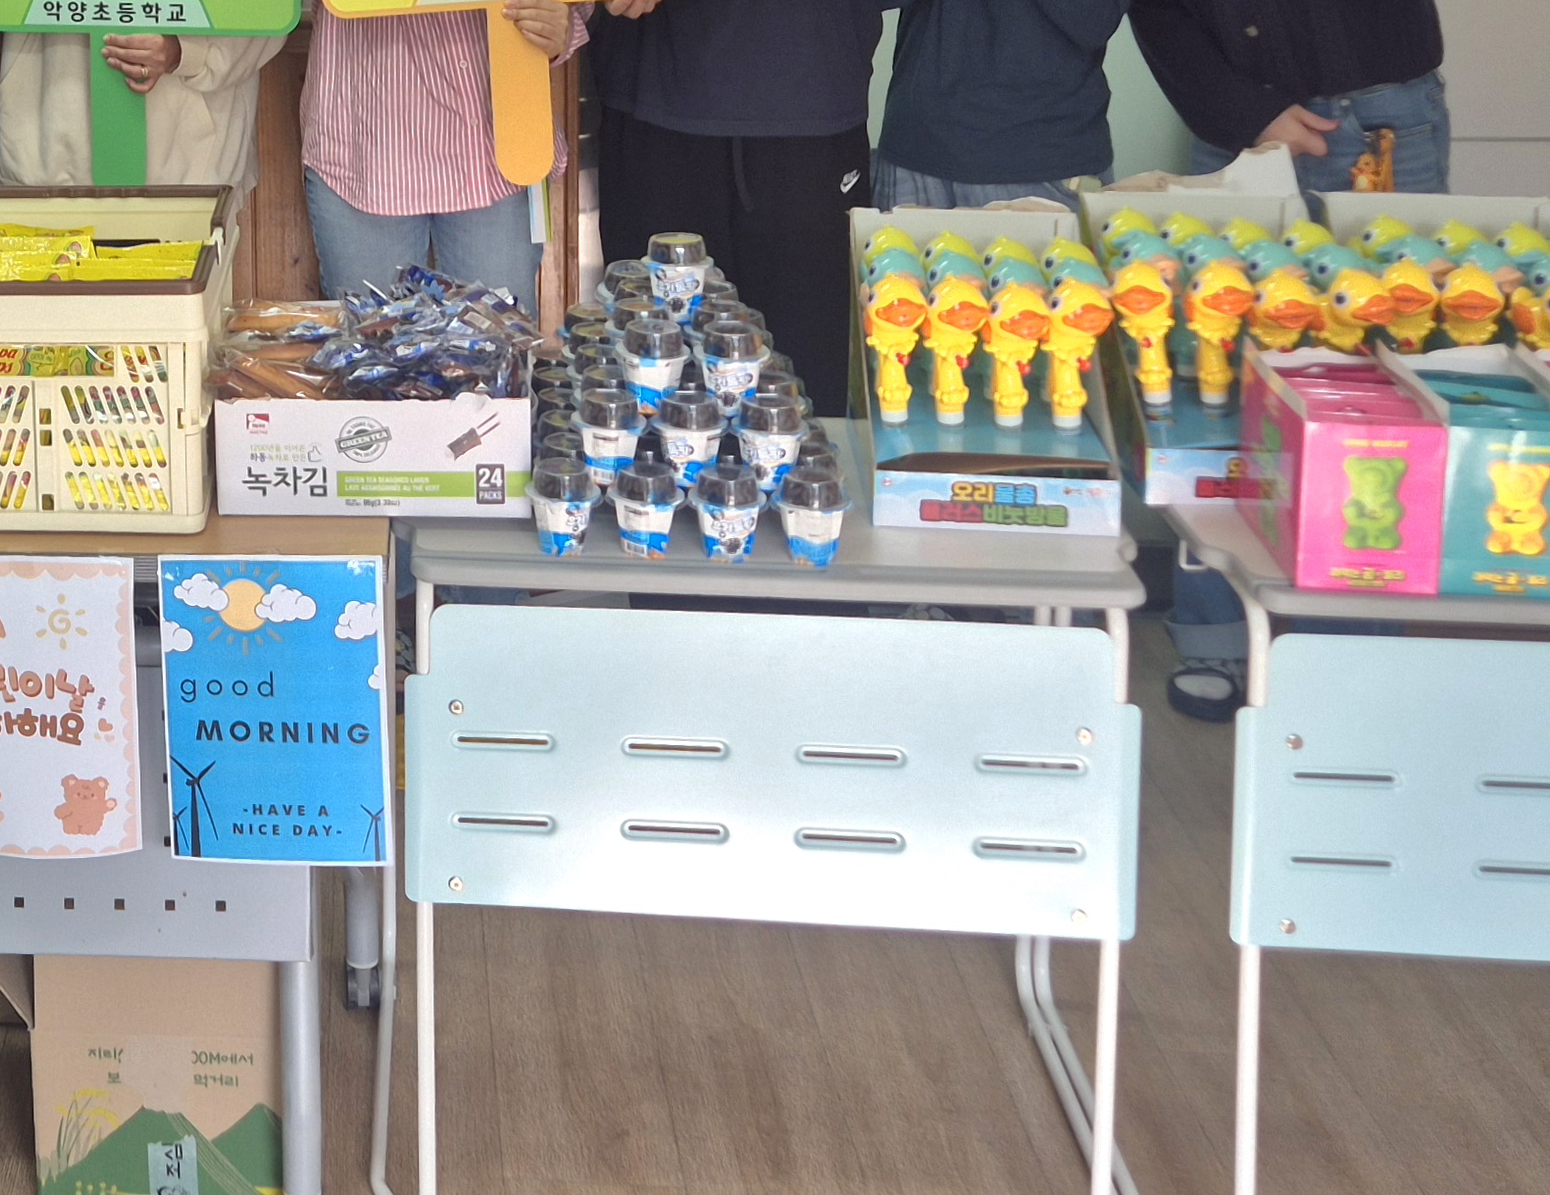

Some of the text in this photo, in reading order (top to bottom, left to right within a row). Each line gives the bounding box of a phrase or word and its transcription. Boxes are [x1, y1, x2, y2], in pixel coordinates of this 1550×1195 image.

[43, 0, 187, 23] 악양초등학교
[242, 466, 328, 497] 녹차김
[477, 468, 503, 488] 24
[479, 491, 503, 500] PACKS
[180, 671, 275, 703] good
[196, 720, 370, 744] MORNING
[318, 805, 329, 817] A
[232, 823, 280, 836] NICE
